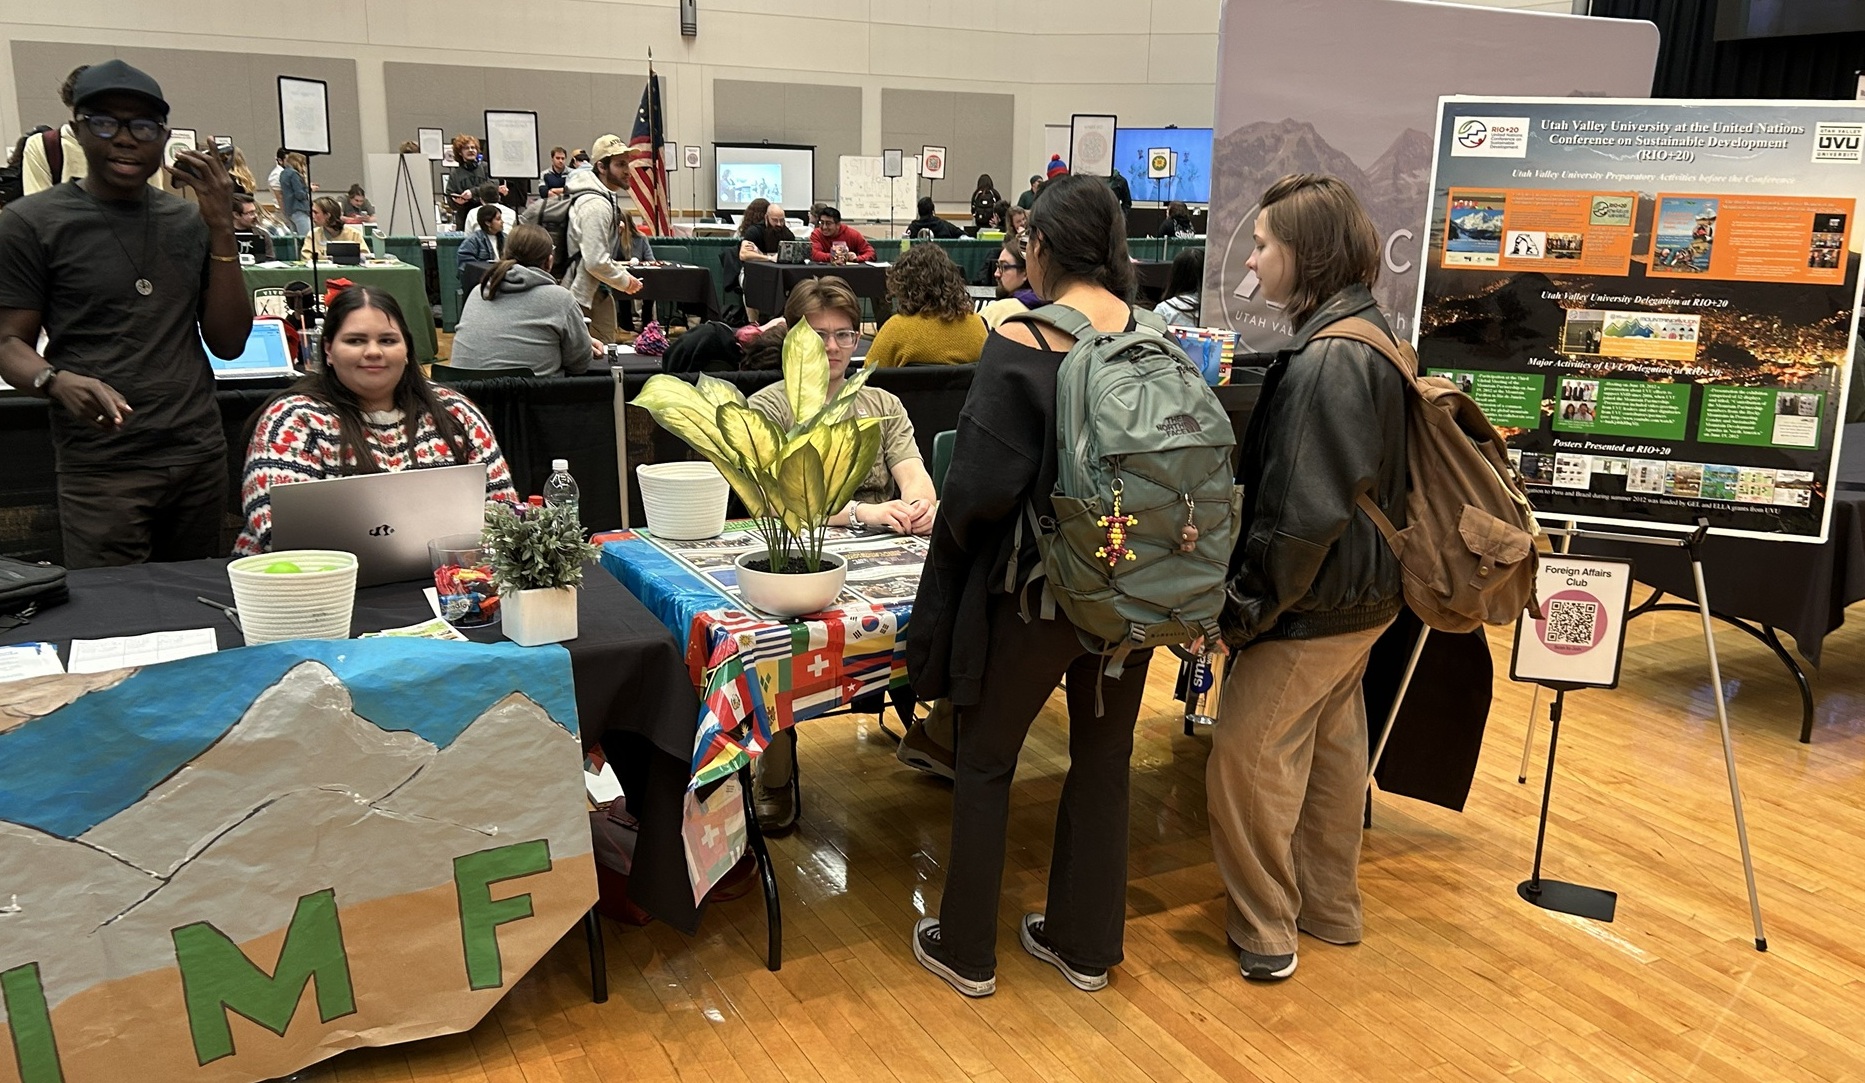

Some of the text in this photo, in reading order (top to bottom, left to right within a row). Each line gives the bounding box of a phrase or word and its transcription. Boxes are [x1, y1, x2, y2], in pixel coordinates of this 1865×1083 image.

[1541, 120, 1805, 135] Utah Valley University at the United Nations
[1549, 134, 1788, 150] Conference on Sustainable Development
[1819, 137, 1859, 149] UVU
[1637, 149, 1695, 162] (RIO+20)
[1512, 169, 1796, 184] Utah Valley University Preparatory Activities before the Conference
[1540, 291, 1562, 300] Utah
[1564, 292, 1589, 301] Valley
[1590, 294, 1632, 304] University
[1634, 296, 1679, 306] Delegation
[1692, 298, 1728, 308] RIO+20
[1236, 310, 1294, 337] UTAH VAL
[1527, 358, 1553, 368] Major
[1555, 360, 1591, 369] Activities
[1593, 361, 1603, 370] of
[1604, 362, 1625, 371] UVU
[1627, 364, 1672, 375] Delegation
[1156, 423, 1184, 431] NORTH
[1553, 439, 1583, 448] Posters
[1584, 441, 1625, 452] Presented
[1636, 445, 1671, 455] RIO+20
[1593, 493, 1609, 501] during
[1545, 566, 1612, 578] Foreign Affairs
[1566, 578, 1588, 586] Club
